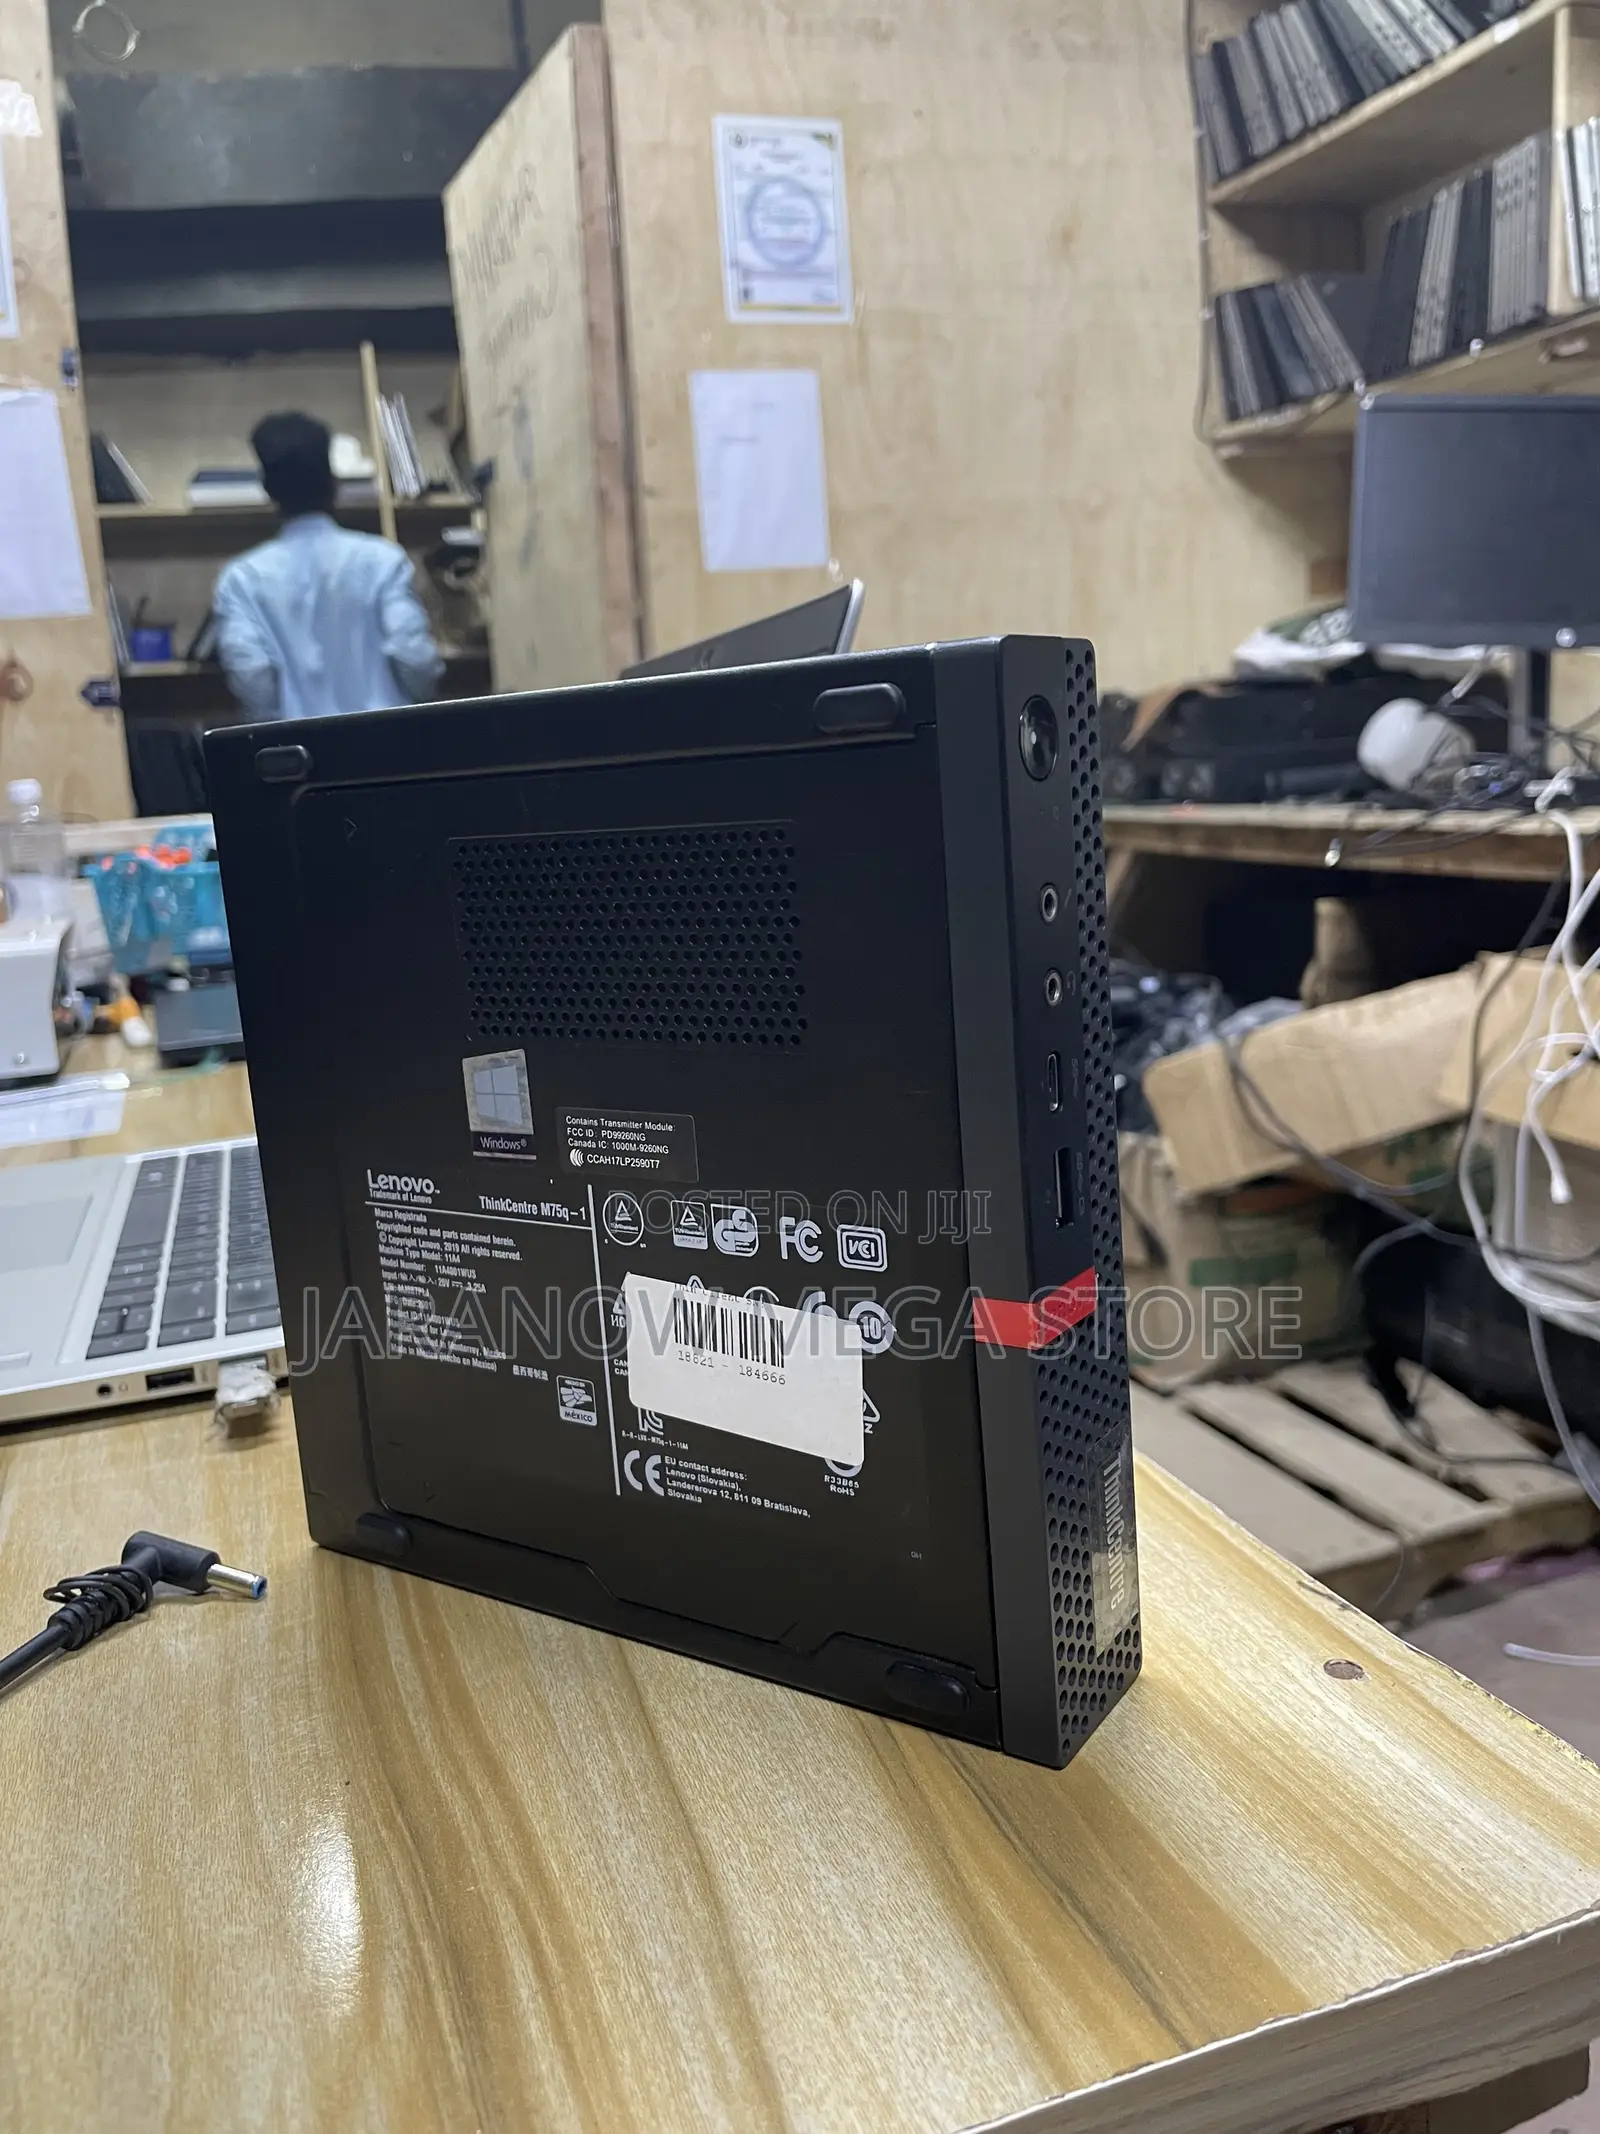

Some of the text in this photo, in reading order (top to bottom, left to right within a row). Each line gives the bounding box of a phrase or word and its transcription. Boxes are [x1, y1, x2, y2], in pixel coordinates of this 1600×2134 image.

[566, 1115, 675, 1132] Contains Transmitter Module:
[567, 1127, 583, 1137] FCC
[568, 1138, 596, 1149] Canada
[410, 1193, 432, 1204] Lenovo
[479, 1195, 538, 1216] ThinkCentre
[374, 1208, 394, 1219] Marca
[413, 1226, 428, 1236] code
[429, 1228, 441, 1237] and
[442, 1230, 459, 1240] parts
[460, 1232, 491, 1244] contained
[388, 1234, 417, 1247] Copyright
[461, 1244, 470, 1254] All
[472, 1246, 491, 1258] rights
[492, 1249, 523, 1261] reserved.
[405, 1247, 420, 1260] Type
[380, 1256, 399, 1268] Model
[860, 1316, 882, 1340] 10
[462, 1357, 471, 1366] en
[472, 1357, 498, 1373] Mexico)
[624, 1450, 664, 1497] CE
[665, 1455, 748, 1481] EU contact address:
[665, 1467, 696, 1481] Lenovo
[666, 1478, 718, 1496] Landererova
[734, 1492, 749, 1503] 811
[751, 1496, 762, 1506] 09
[667, 1488, 703, 1503] Slovakia
[829, 1484, 855, 1497] RoHS
